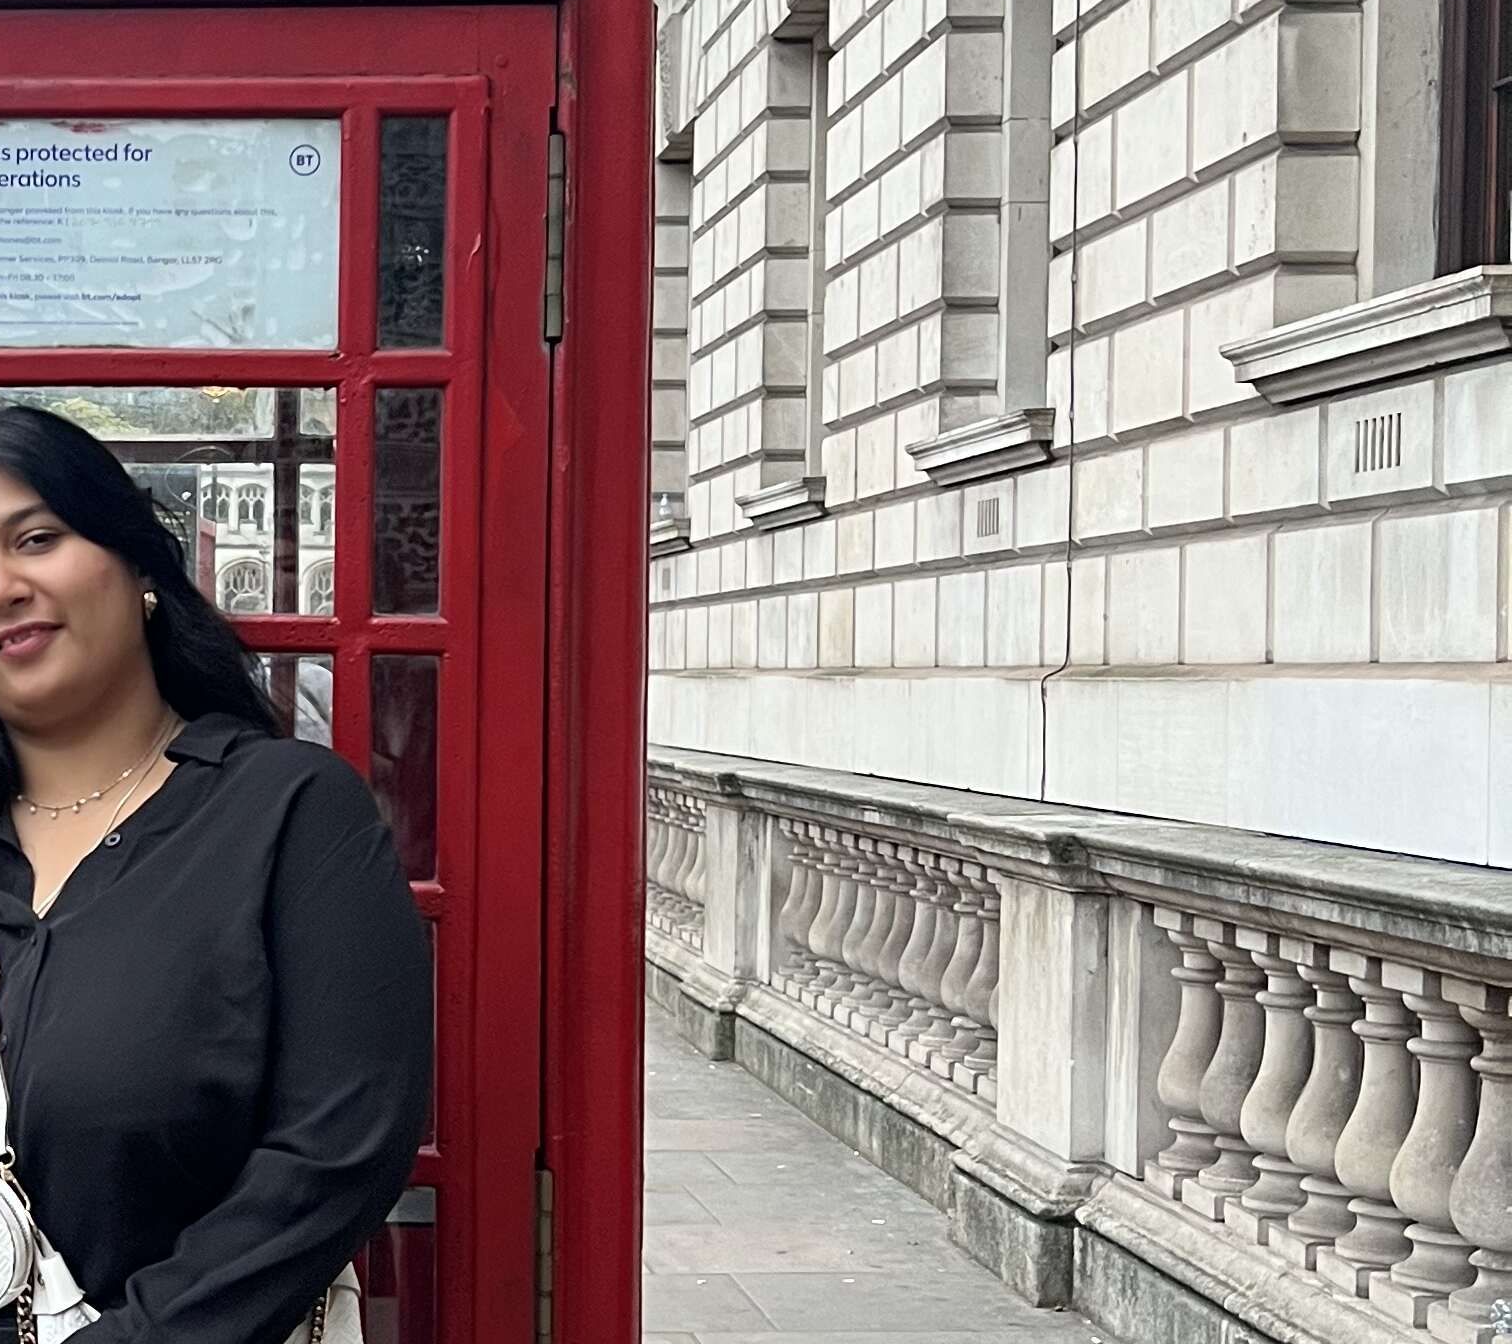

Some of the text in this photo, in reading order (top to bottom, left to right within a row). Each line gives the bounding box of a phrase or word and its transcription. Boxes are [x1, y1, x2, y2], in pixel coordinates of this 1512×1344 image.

[16, 143, 118, 165] protected
[123, 143, 153, 162] for
[295, 154, 313, 167] BT
